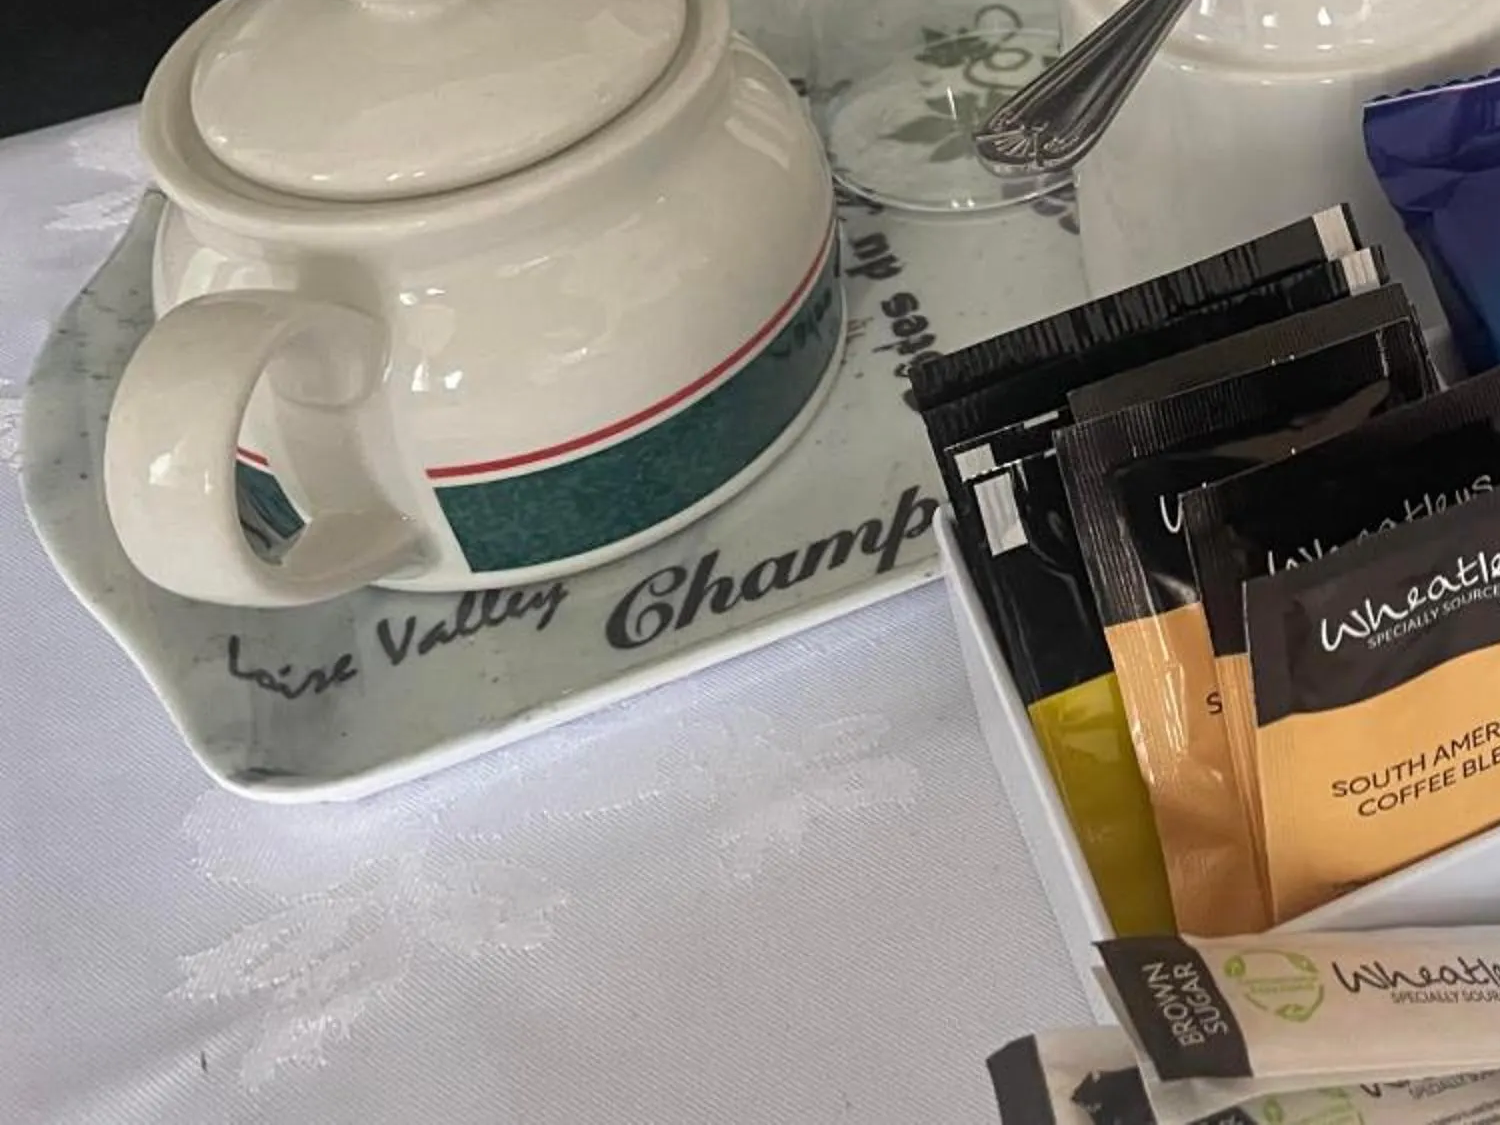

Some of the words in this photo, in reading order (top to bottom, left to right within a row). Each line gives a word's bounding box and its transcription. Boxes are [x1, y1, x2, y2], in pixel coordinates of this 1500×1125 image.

[377, 581, 568, 666] Valley
[1367, 607, 1439, 649] SPECIALLY
[1331, 752, 1427, 798] SOUTH
[1358, 765, 1457, 817] COFFEE
[1142, 961, 1206, 1047] BROWN
[1173, 960, 1229, 1036] SUGAR
[1391, 989, 1461, 1004] SPECIALLY
